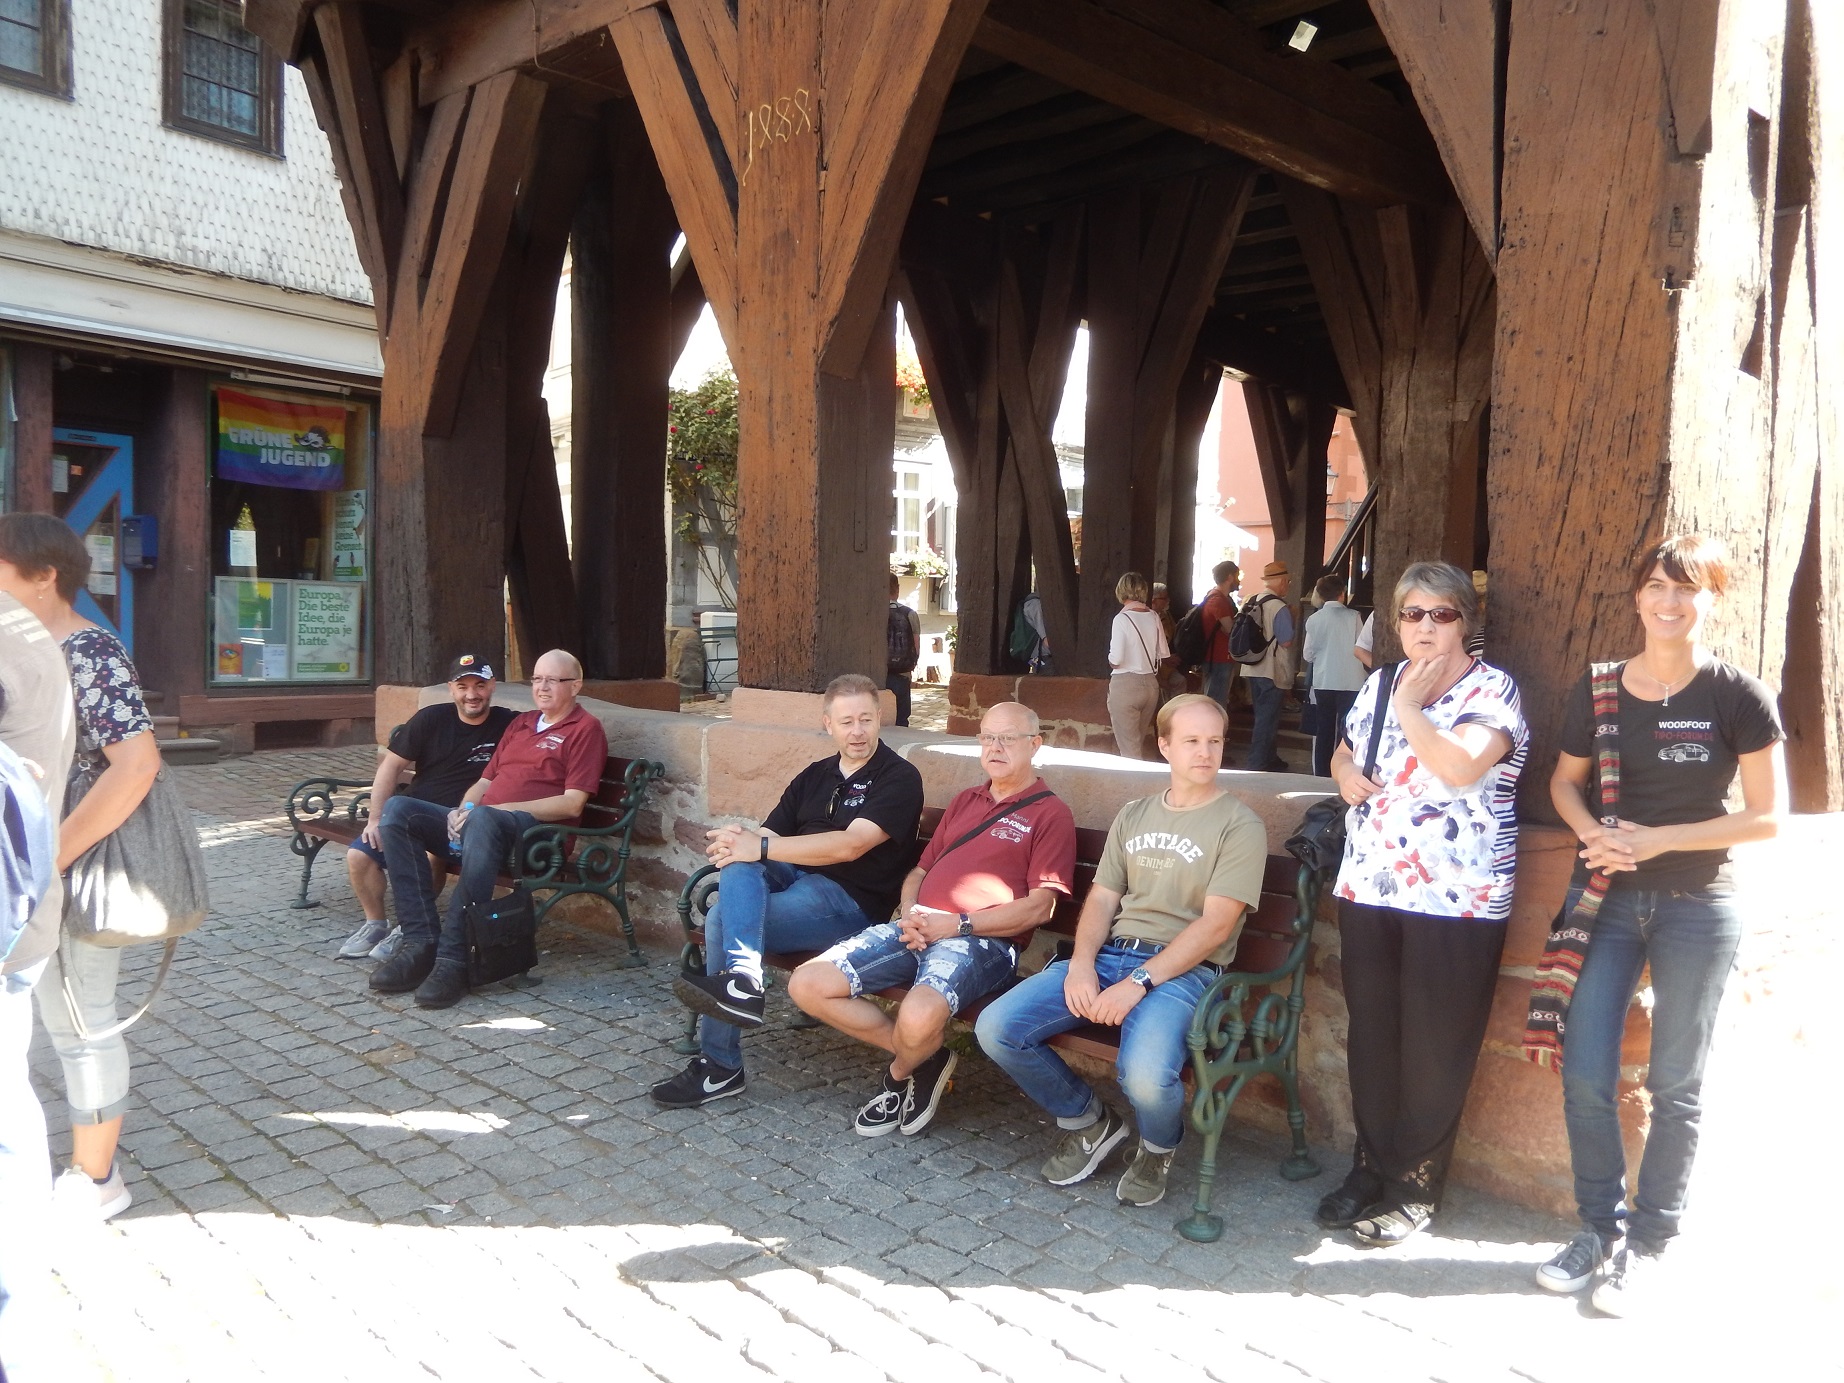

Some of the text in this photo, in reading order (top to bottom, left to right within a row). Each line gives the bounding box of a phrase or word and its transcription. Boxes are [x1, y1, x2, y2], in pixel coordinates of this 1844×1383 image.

[228, 427, 294, 449] GRÜNE
[260, 448, 331, 467] JUGEND
[298, 600, 350, 612] Die beste
[298, 612, 346, 624] Idee, die
[298, 623, 353, 637] Europa je
[297, 635, 329, 646] hatte.
[1658, 721, 1712, 729] WOODFOOT
[1654, 731, 1714, 741] TIPO-FORUMDE
[1125, 832, 1204, 864] VINTAGE
